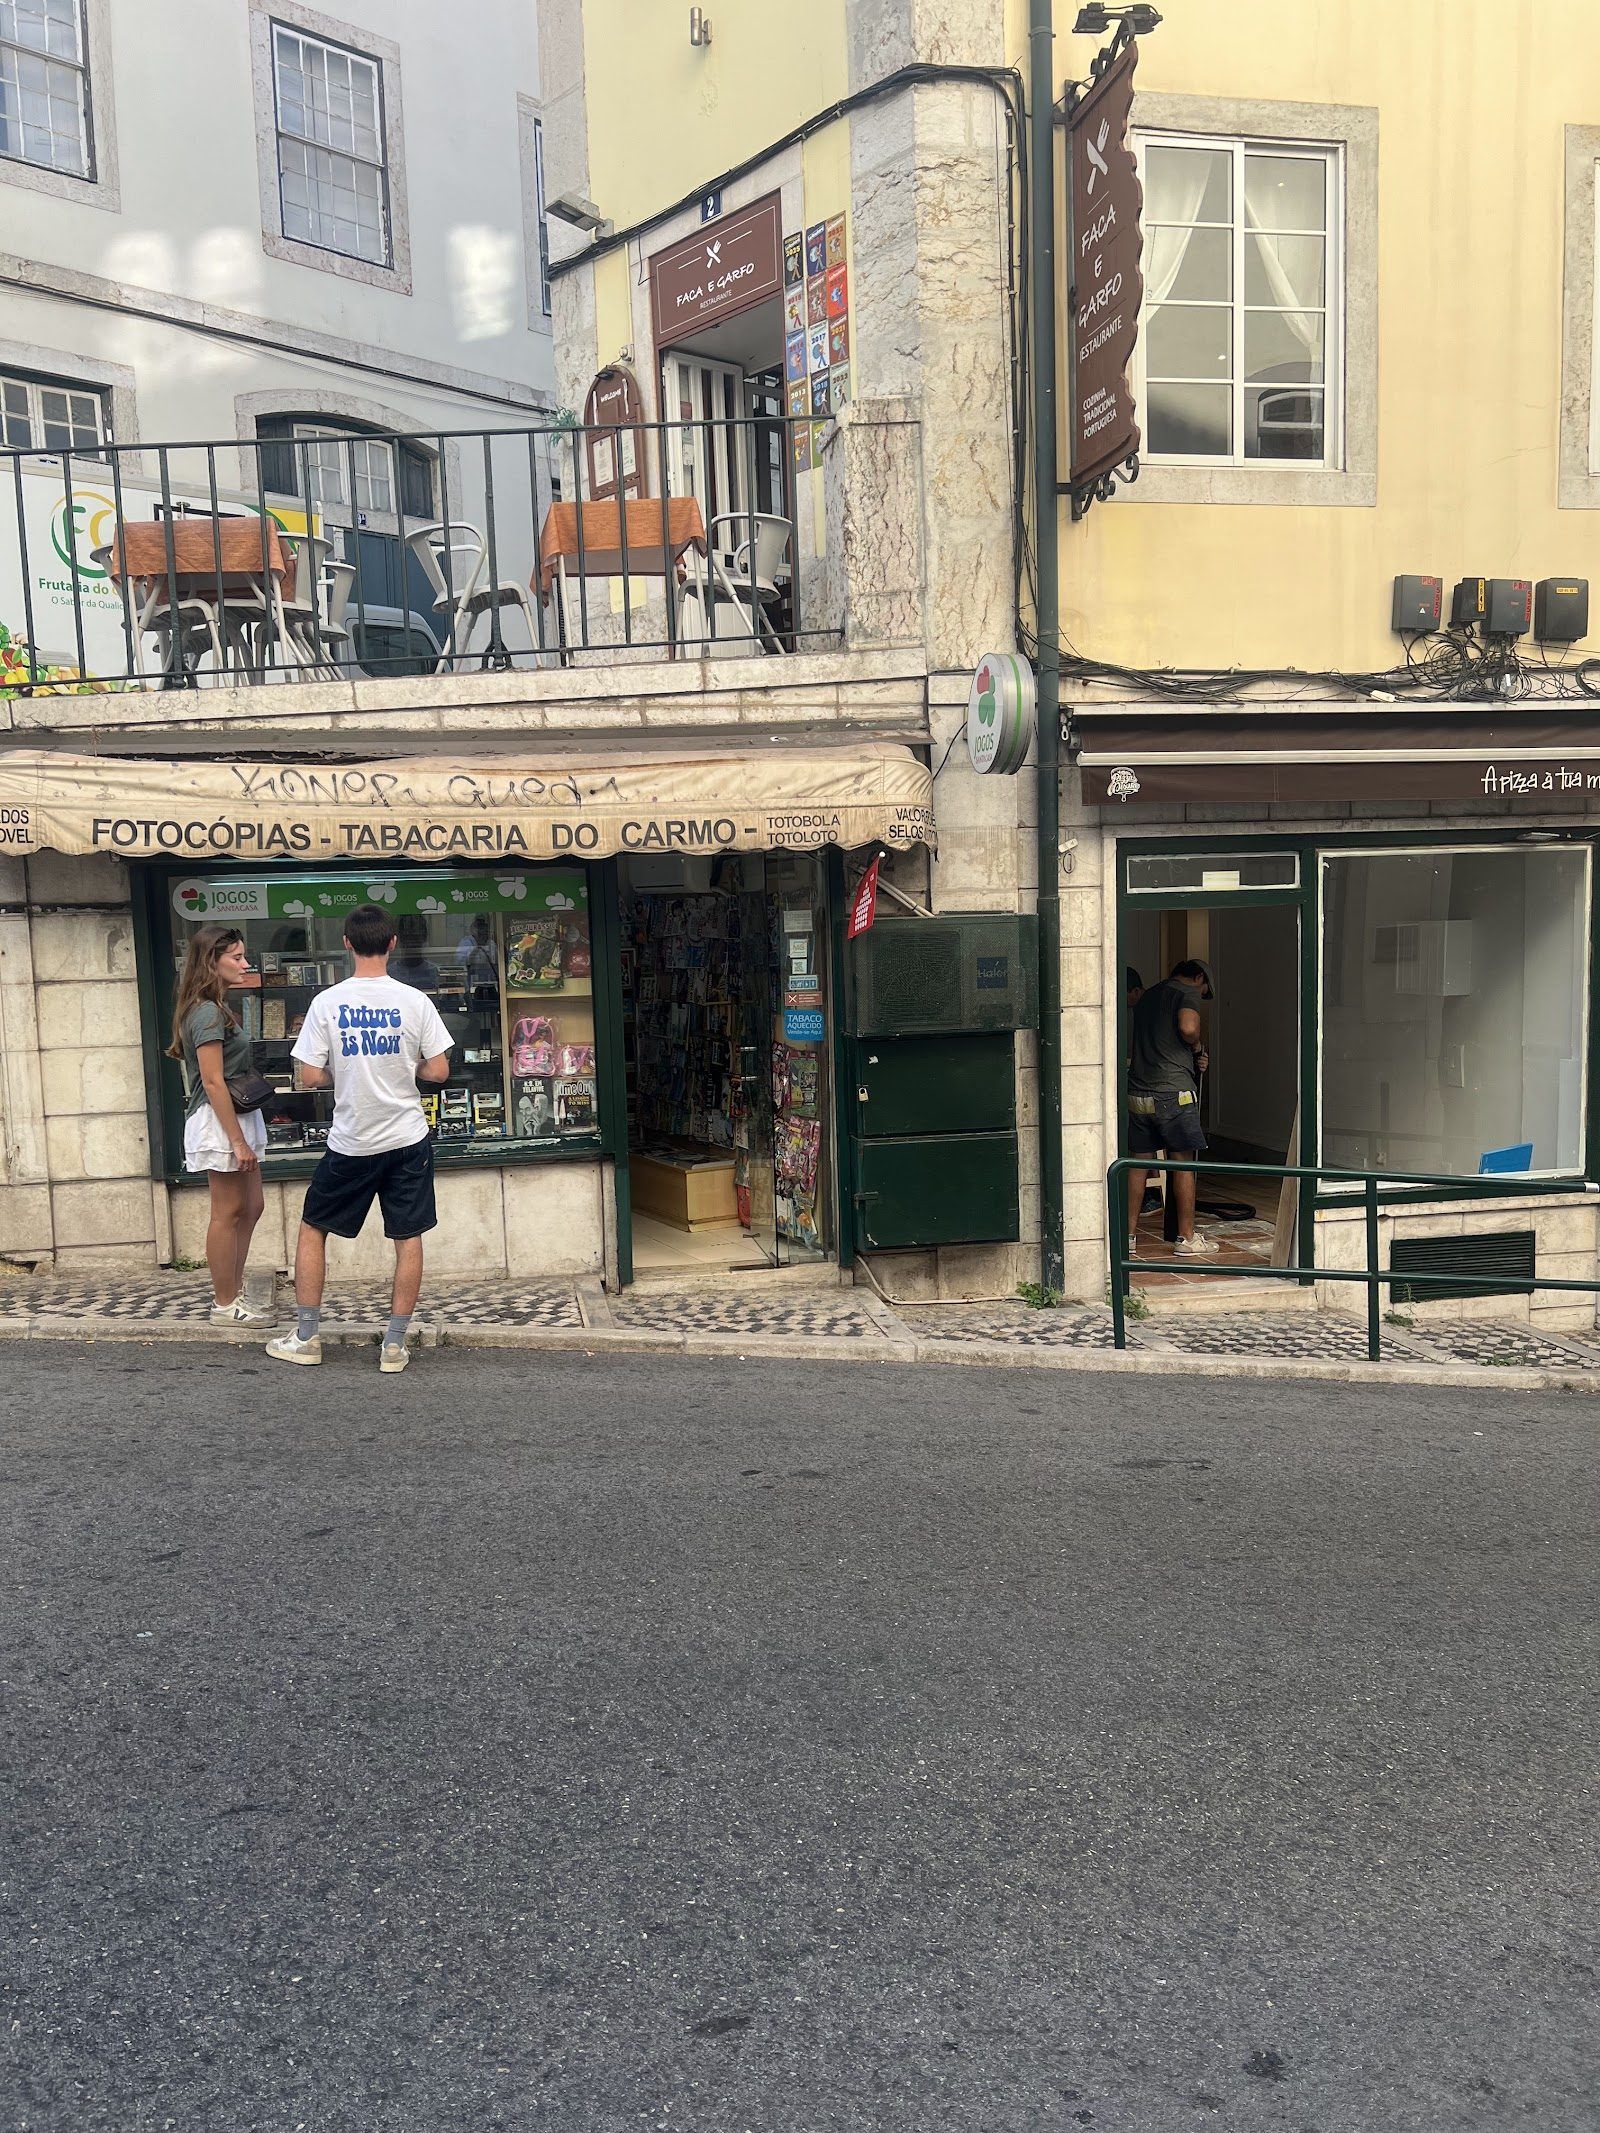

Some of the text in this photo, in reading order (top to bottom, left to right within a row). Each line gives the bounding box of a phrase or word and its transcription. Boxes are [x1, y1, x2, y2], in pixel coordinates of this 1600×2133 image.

[706, 195, 716, 218] 2
[1081, 203, 1117, 258] FACA
[1094, 254, 1103, 279] E
[676, 262, 755, 308] FACA E GARFO
[699, 288, 733, 310] RESTAURANTE
[1078, 272, 1123, 329] GARFO
[790, 388, 806, 400] 2013
[1082, 386, 1107, 411] COZINHA
[1083, 393, 1118, 425] TRADICIONAL
[1083, 408, 1118, 440] PORTUGUESA
[39, 577, 90, 594] Frutaia
[92, 582, 109, 595] do
[60, 596, 84, 607] Sabr
[86, 598, 97, 608] da
[974, 732, 995, 760] JOGOS
[1480, 765, 1498, 794] A
[1499, 770, 1538, 794] pizza
[1541, 771, 1553, 790] à
[1555, 766, 1582, 790] tua
[0, 809, 29, 824] DOS
[766, 814, 841, 829] TOTOBOLA
[92, 815, 311, 851] FOTOCÓPIAS
[339, 823, 528, 851] TABACARIA
[552, 822, 599, 850] DO
[621, 818, 736, 848] CARMO
[767, 829, 838, 845] TOTOLOTO
[888, 824, 924, 840] SELOS
[211, 890, 258, 909] JOGOS
[333, 894, 358, 904] JOGOS
[465, 890, 489, 901] JOGOS
[216, 903, 259, 913] SANTACASA
[338, 1004, 401, 1029] Future
[786, 1022, 822, 1030] AQUECIDO
[787, 1014, 823, 1023] TABACO
[340, 1030, 401, 1057] is Now
[554, 1080, 577, 1096] Time
